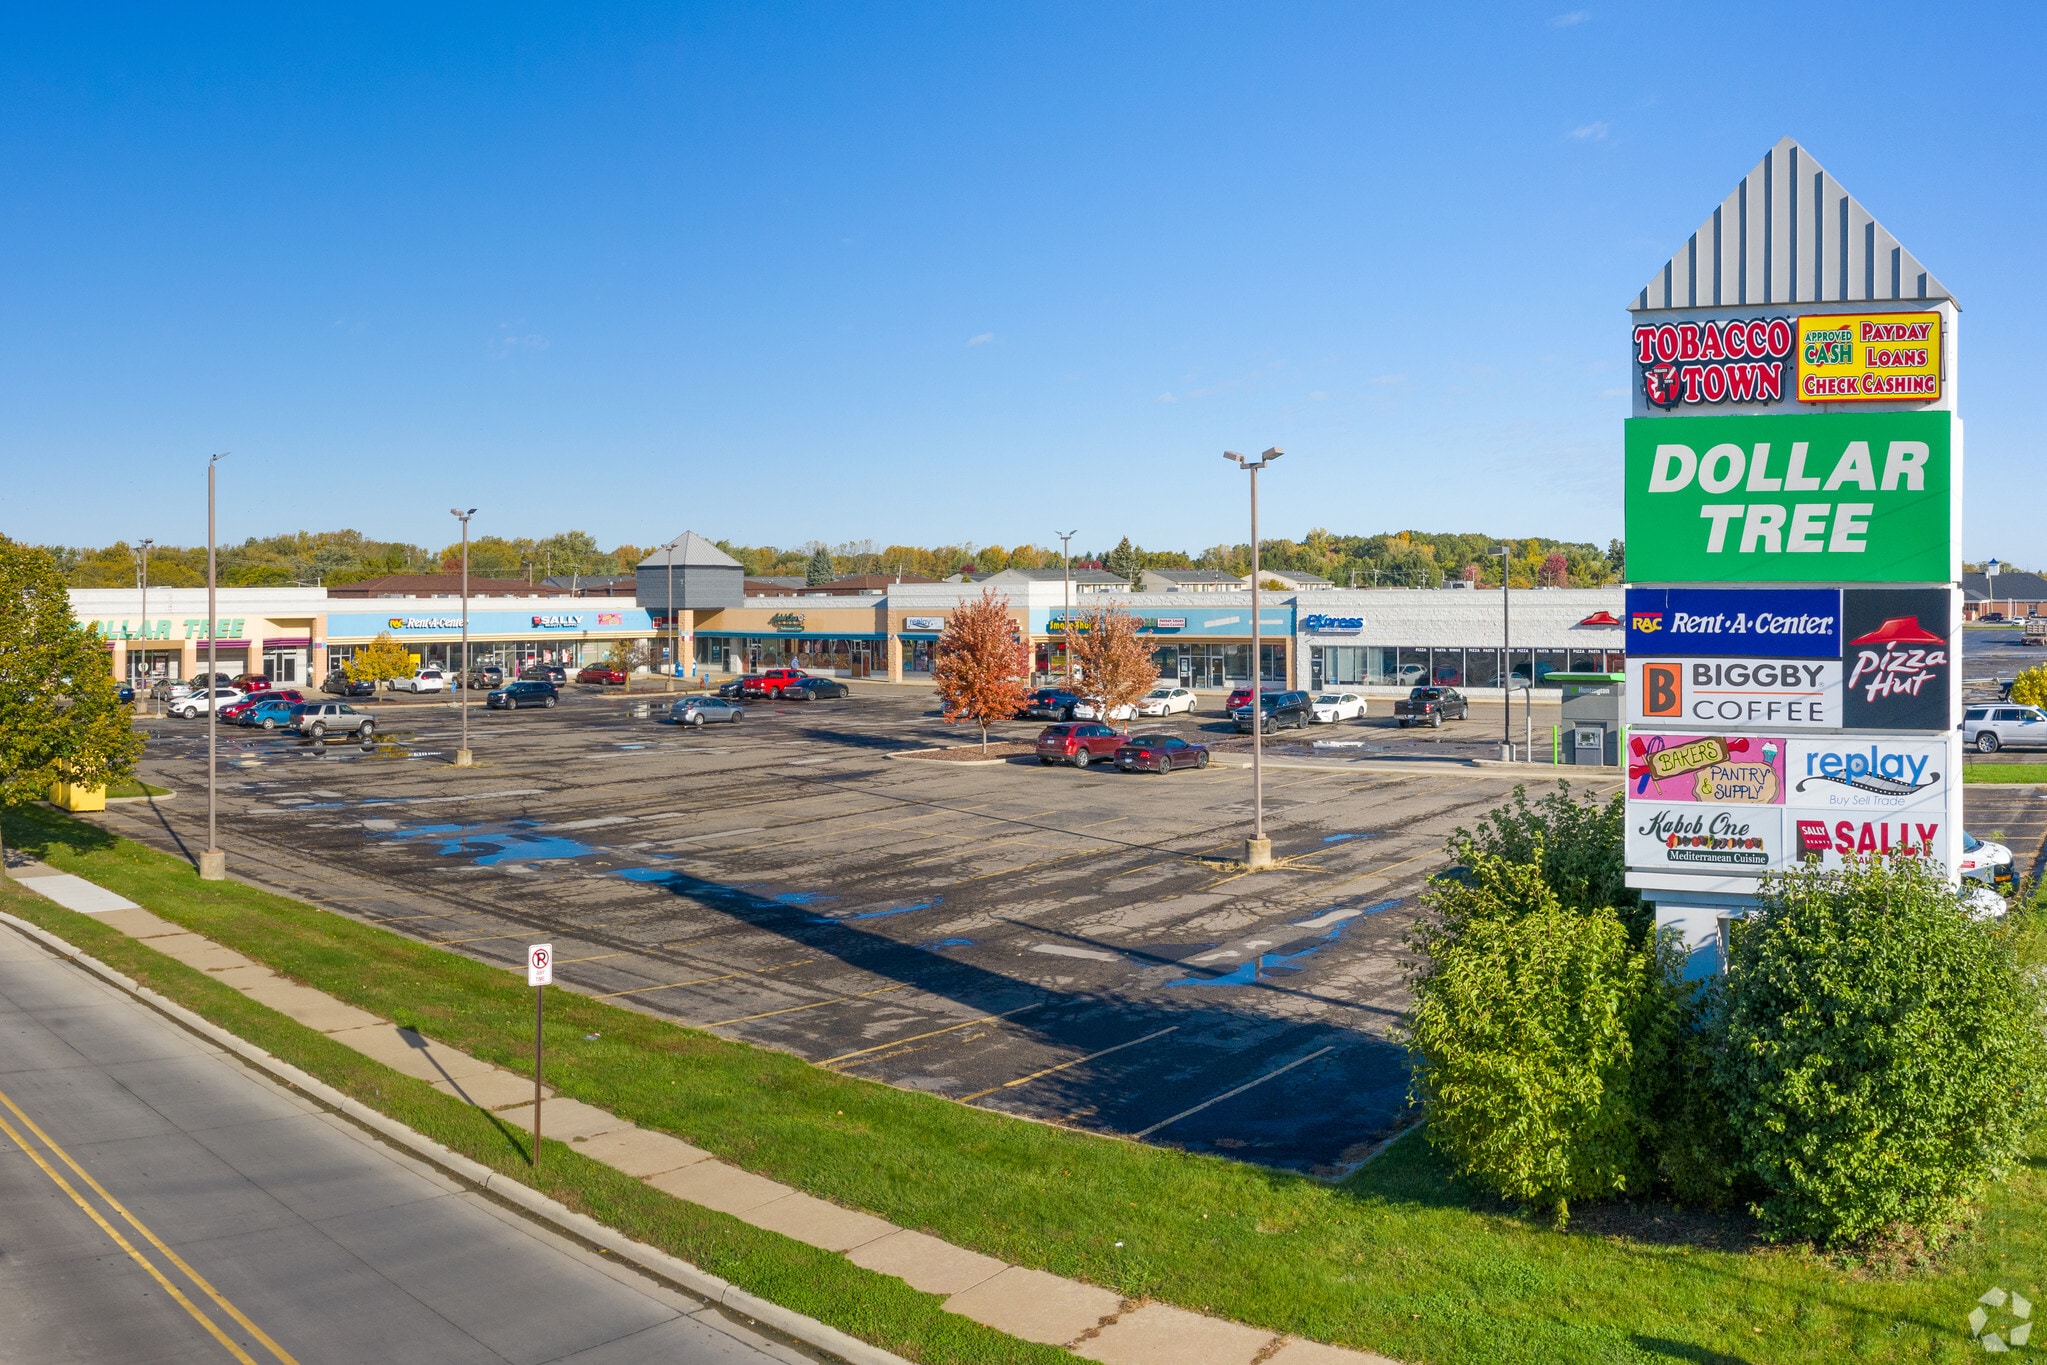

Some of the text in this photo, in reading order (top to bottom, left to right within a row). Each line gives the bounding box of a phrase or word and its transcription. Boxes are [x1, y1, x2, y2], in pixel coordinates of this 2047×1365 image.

[1635, 320, 1791, 362] TOBACCO
[1805, 330, 1853, 342] APPROVED
[1861, 322, 1932, 342] PAYDAY
[1804, 344, 1853, 365] CASH
[1867, 348, 1927, 367] LOANS
[1682, 363, 1782, 402] TOWN
[1803, 373, 1935, 395] CHECK CASHING
[1648, 441, 1930, 493] DOLLAR
[1700, 503, 1874, 553] TREE
[541, 616, 583, 624] SALLY
[1050, 620, 1074, 630] Smoe
[1632, 617, 1663, 634] RAC
[1692, 664, 1825, 688] BIGGBY
[1849, 641, 1947, 690] Pizza
[1578, 686, 1610, 696] Huntington
[1649, 668, 1677, 713] B
[1867, 669, 1935, 703] Hut
[1693, 700, 1824, 722] COFFEE
[1658, 741, 1719, 772] BAKER'S
[1807, 745, 1929, 787] replay
[1711, 765, 1771, 785] PANTRY
[1715, 784, 1764, 800] SUPPLY
[1829, 795, 1905, 806] Buy Sell Trade
[1639, 810, 1750, 842] Kabob One
[1801, 826, 1826, 836] SALLY
[1835, 820, 1939, 857] SALLY
[1670, 851, 1766, 864] Mediterranean Cuisine
